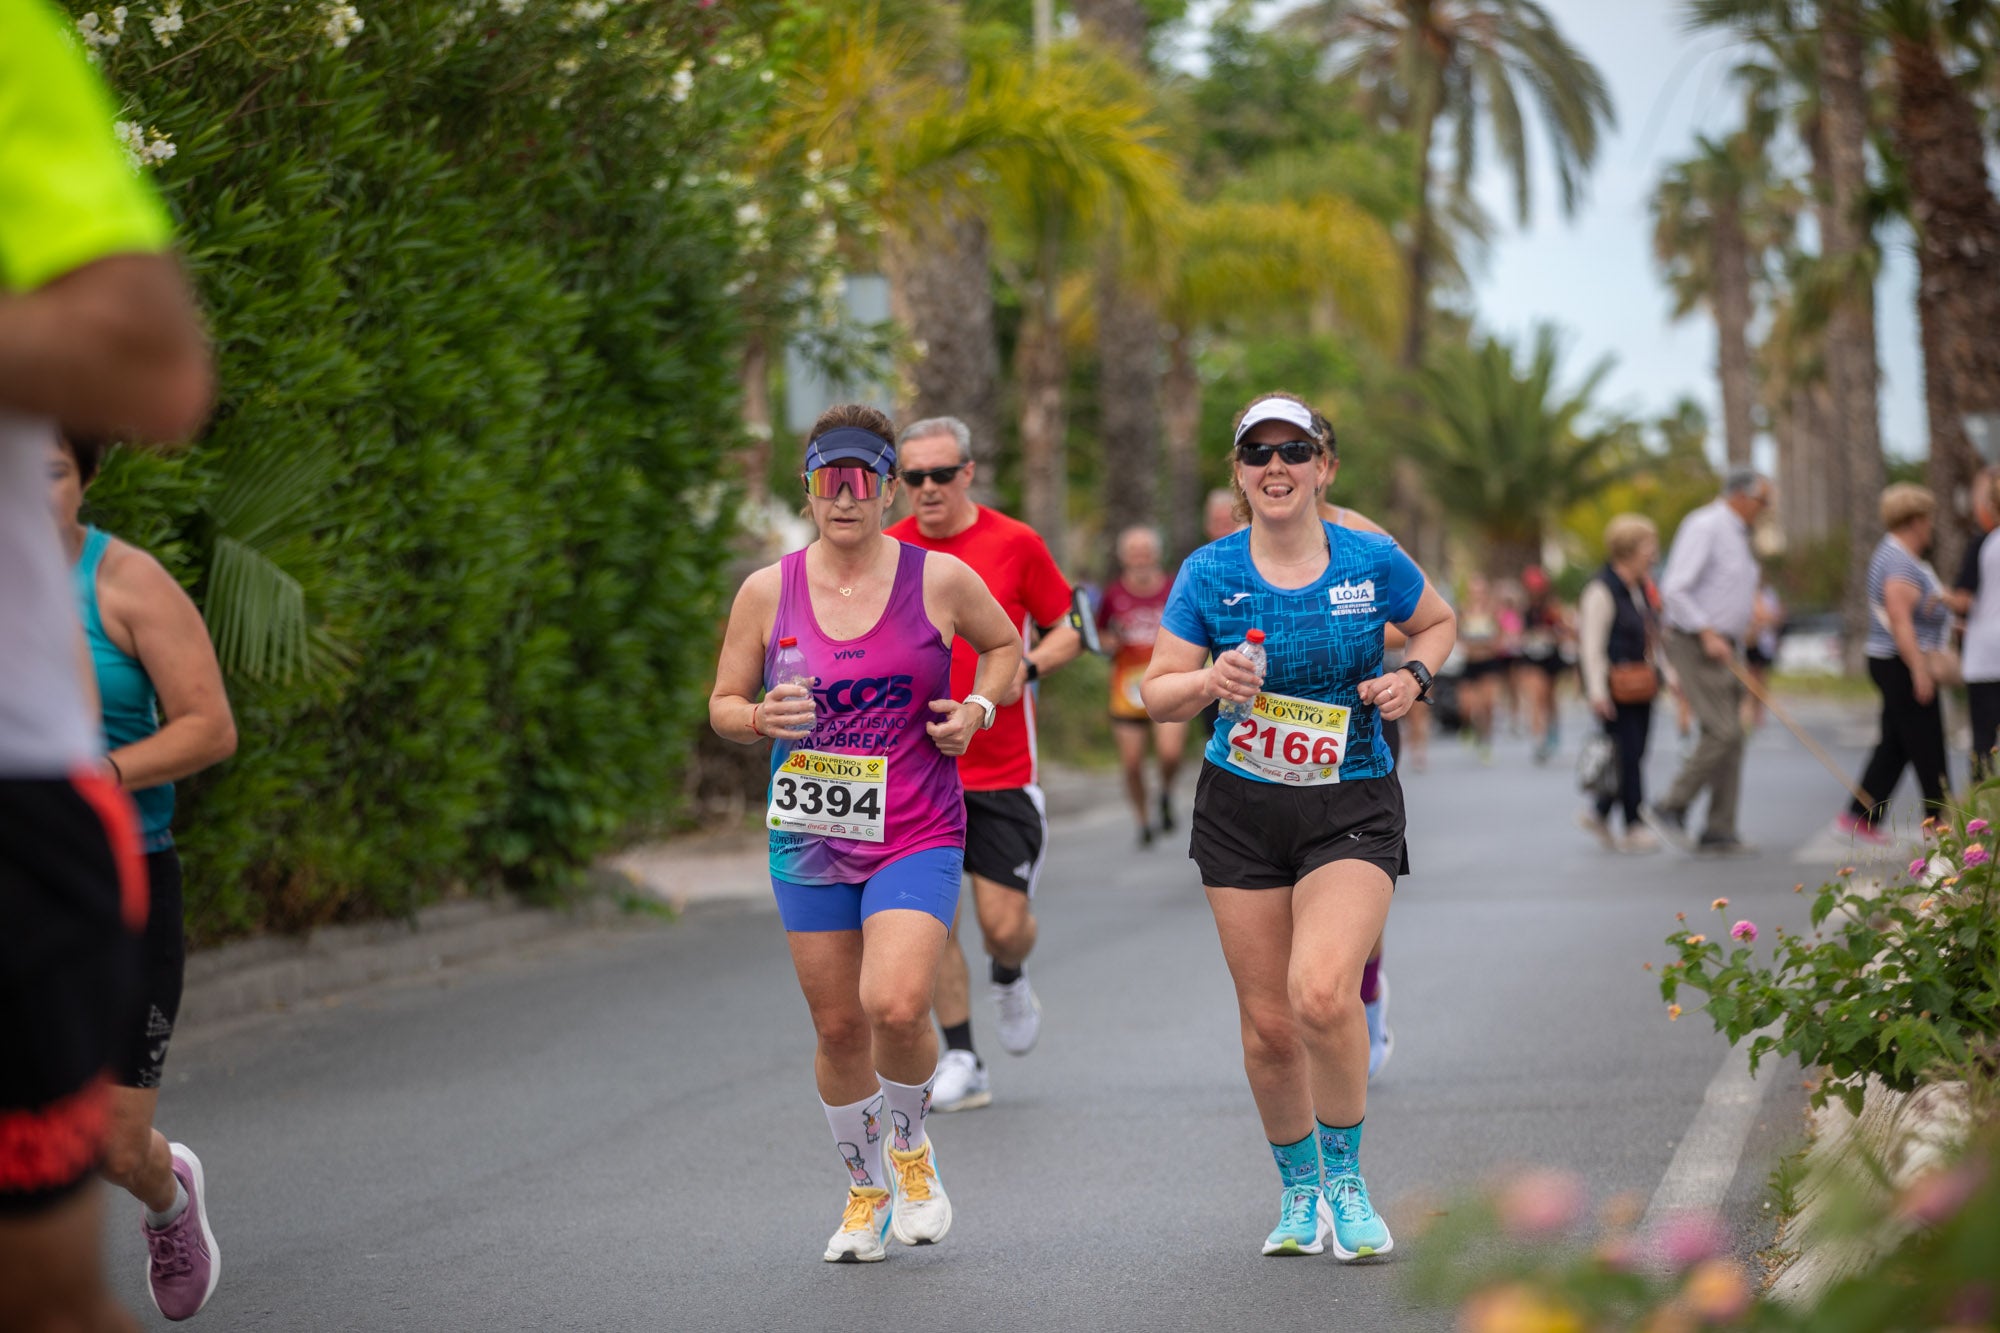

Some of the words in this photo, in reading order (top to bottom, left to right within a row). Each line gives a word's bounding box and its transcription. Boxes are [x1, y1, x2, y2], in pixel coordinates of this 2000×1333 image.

[1336, 588, 1369, 601] LOJA
[833, 649, 866, 660] vive
[1253, 695, 1267, 712] 38
[1268, 698, 1289, 707] GRAN
[1290, 702, 1319, 713] PREMIO
[1265, 702, 1323, 725] FONDO
[1231, 718, 1339, 766] 2166
[790, 753, 807, 769] 38
[809, 754, 828, 763] GRAN
[829, 757, 857, 767] PREMIO
[805, 759, 862, 777] FONDO
[775, 777, 881, 820] 3394
